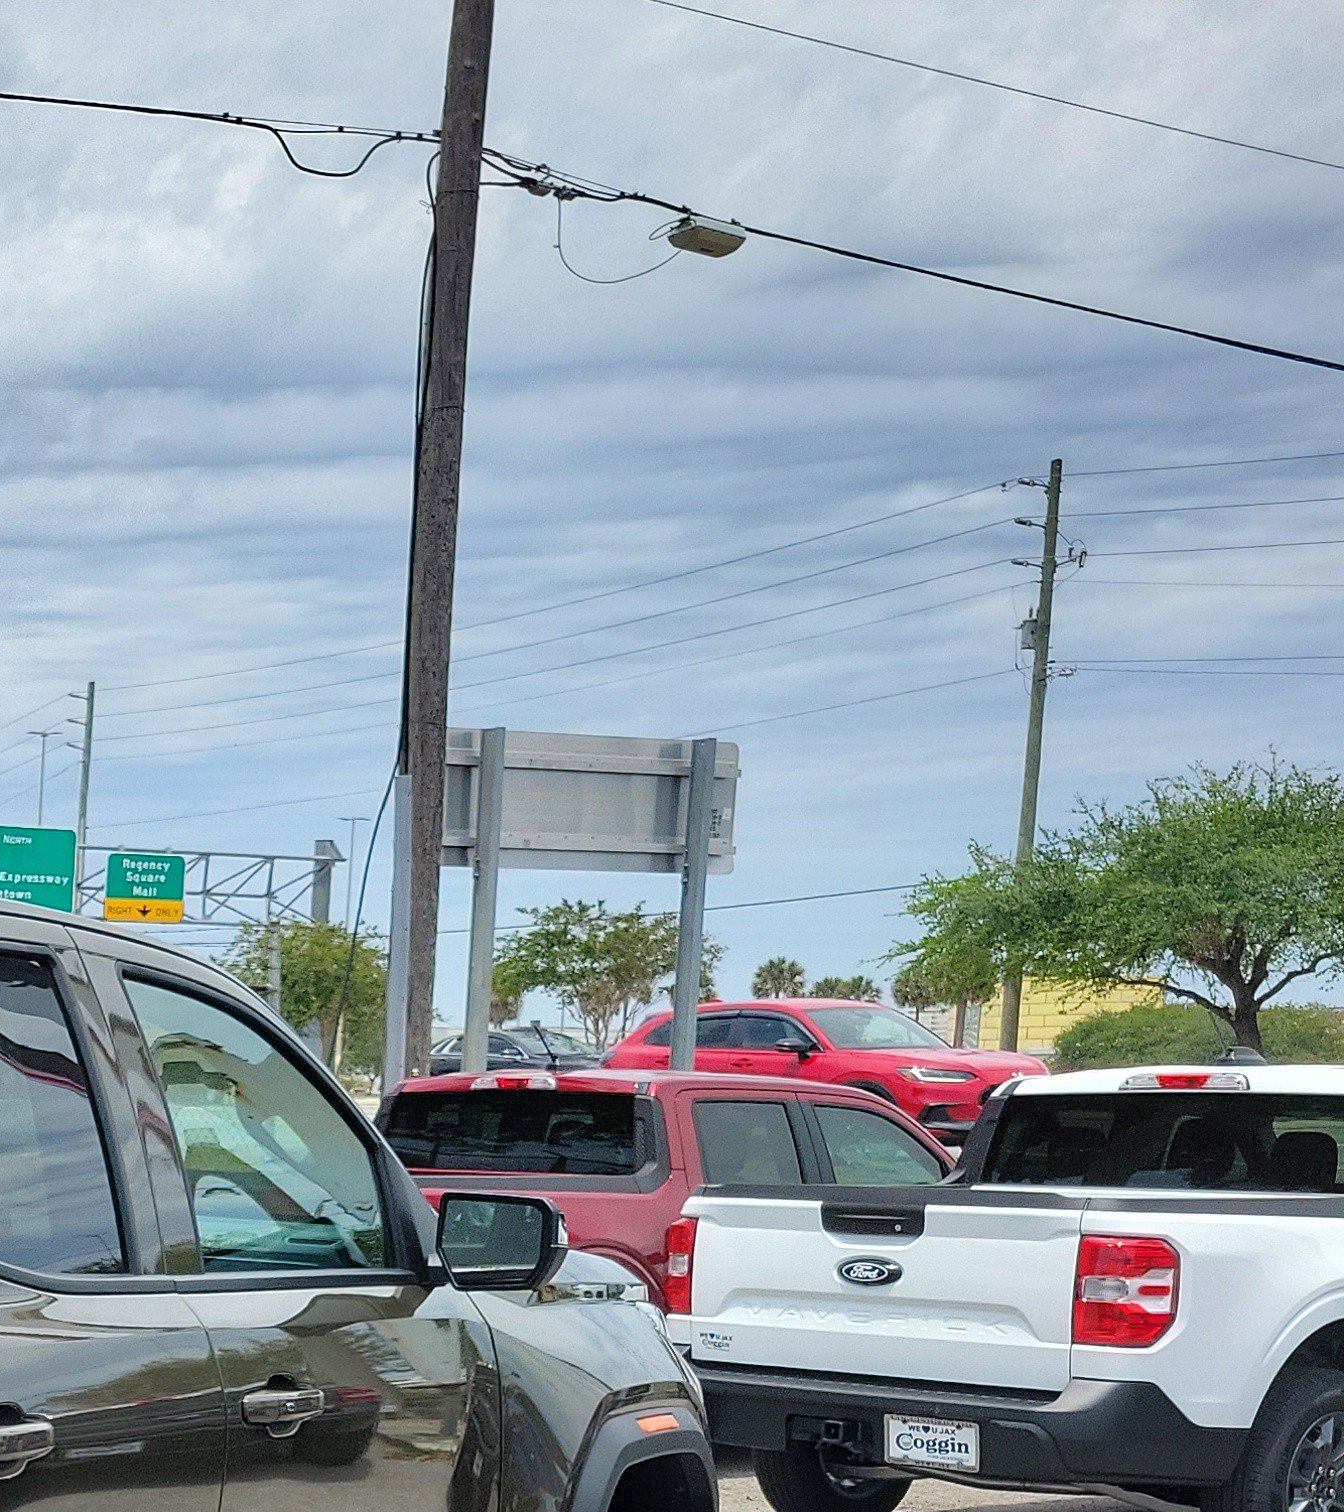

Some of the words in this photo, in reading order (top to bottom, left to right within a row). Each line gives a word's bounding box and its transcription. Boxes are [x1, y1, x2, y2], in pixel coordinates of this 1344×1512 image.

[122, 858, 171, 873] Regency
[0, 871, 69, 887] Expressway
[125, 871, 166, 883] Square
[132, 886, 157, 897] Mall
[107, 906, 132, 915] RIGHT
[155, 907, 180, 918] ONLY
[849, 1263, 880, 1279] Ford
[908, 1424, 921, 1432] WE
[939, 1428, 956, 1436] JAX
[896, 1432, 970, 1455] Coggin
